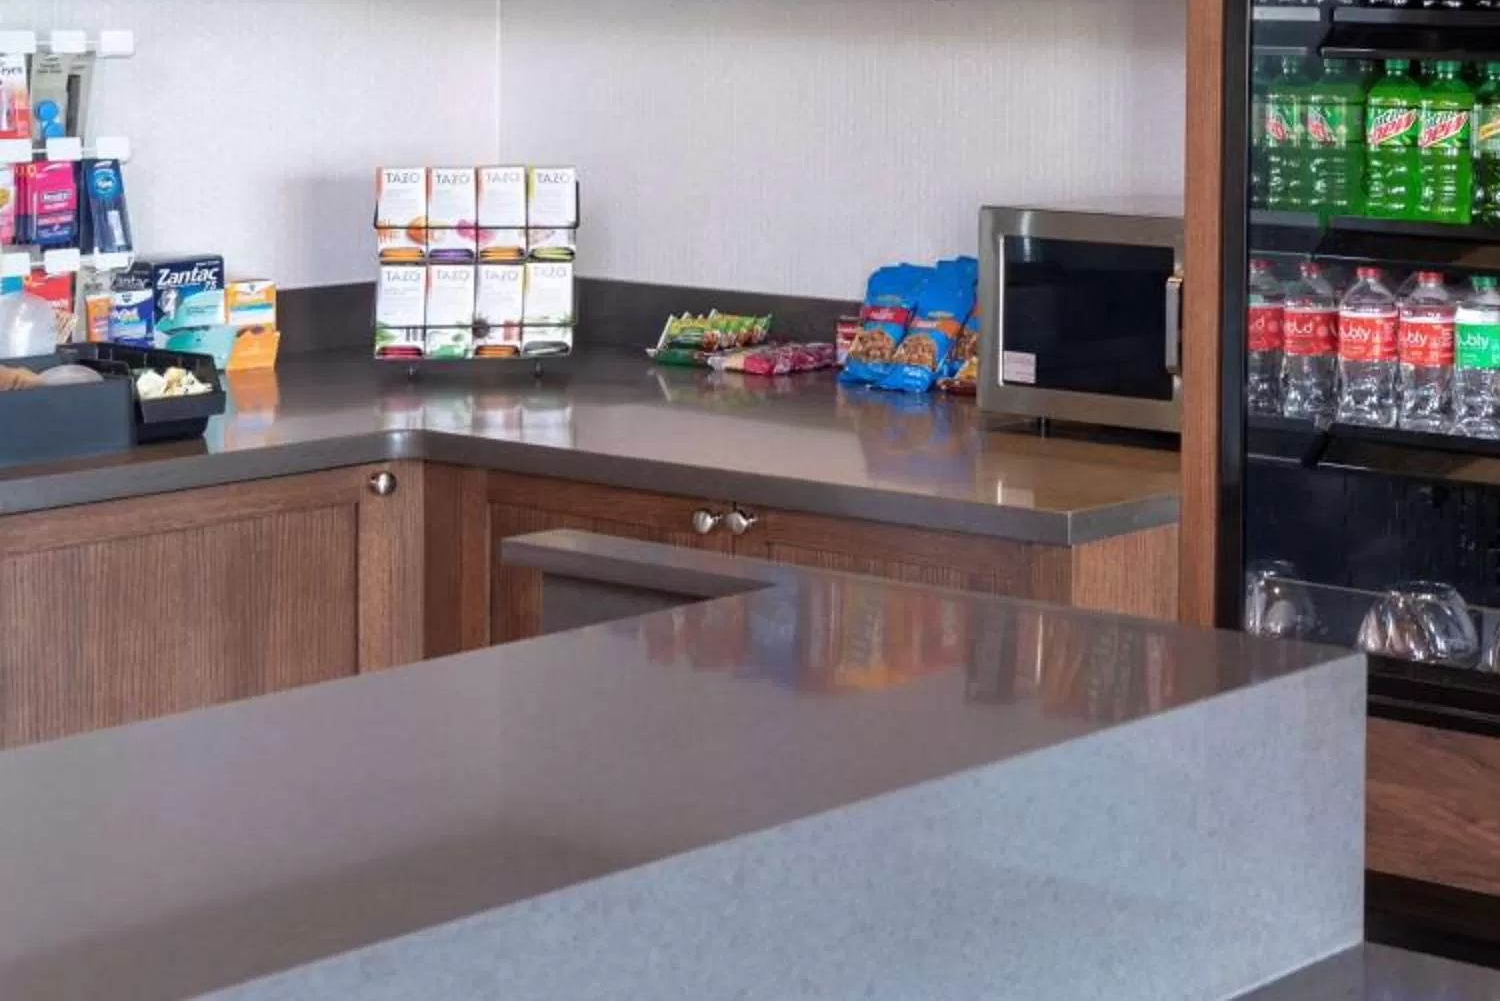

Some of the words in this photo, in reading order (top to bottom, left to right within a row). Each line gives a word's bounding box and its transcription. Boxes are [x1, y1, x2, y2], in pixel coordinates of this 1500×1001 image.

[385, 172, 421, 184] TAZO
[436, 173, 470, 185] TAZO
[536, 172, 571, 184] TAZO
[157, 267, 219, 286] Zantac
[387, 270, 421, 282] TAZO
